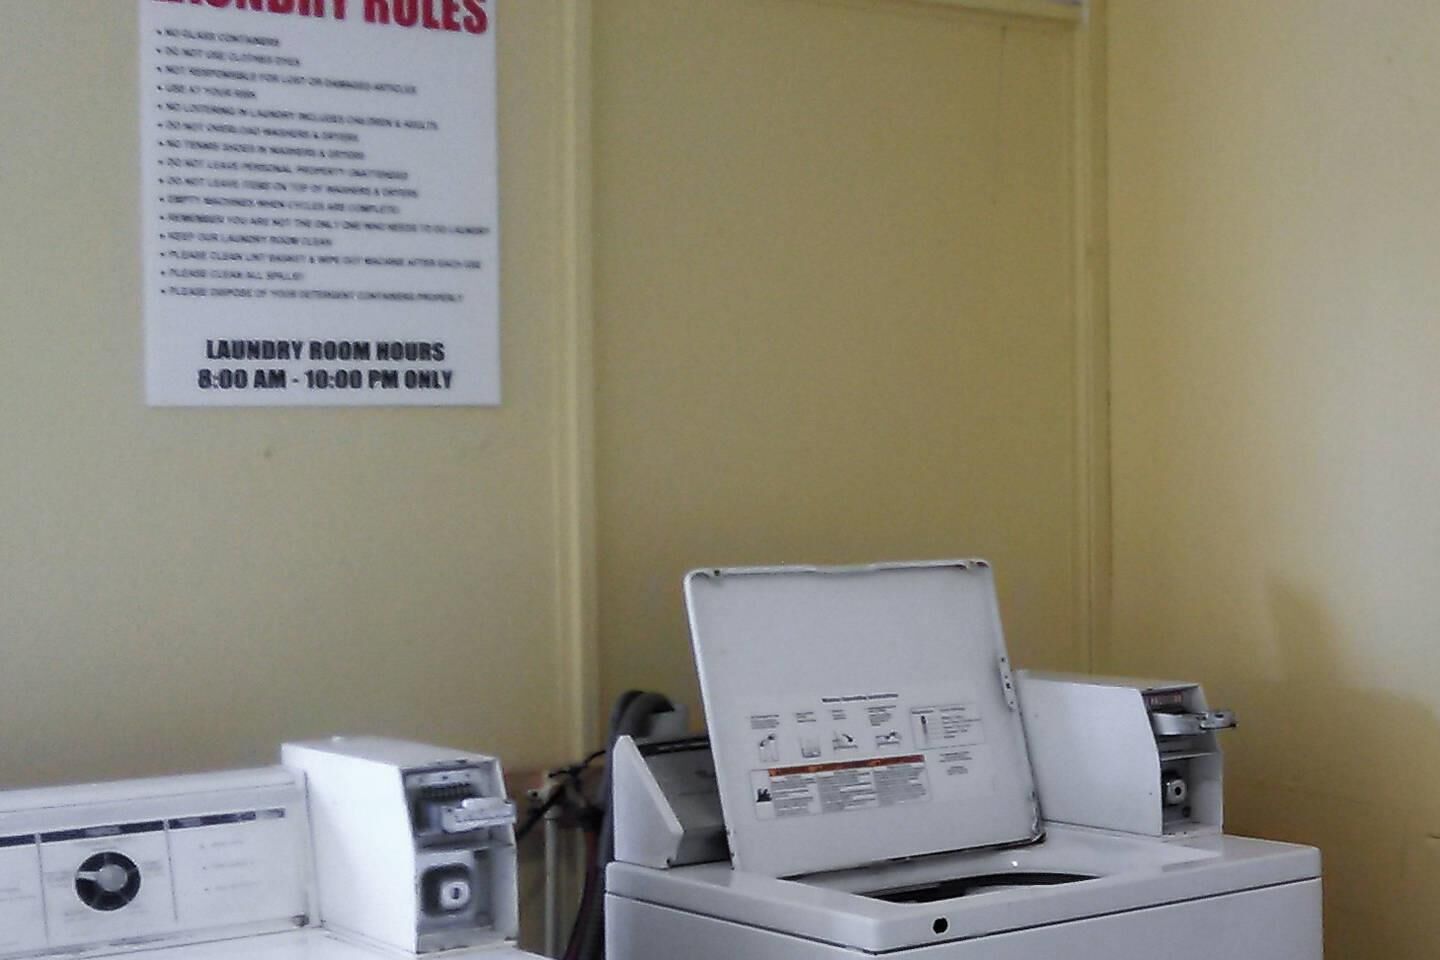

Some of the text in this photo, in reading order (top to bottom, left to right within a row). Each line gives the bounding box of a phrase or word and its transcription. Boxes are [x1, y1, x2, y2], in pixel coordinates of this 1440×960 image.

[206, 340, 445, 361] LAUNDRY ROOM HOURS
[198, 369, 248, 389] 8:00
[253, 369, 287, 389] AM
[304, 369, 362, 389] 10:00
[368, 369, 399, 388] PM
[404, 369, 453, 388] ONLY
